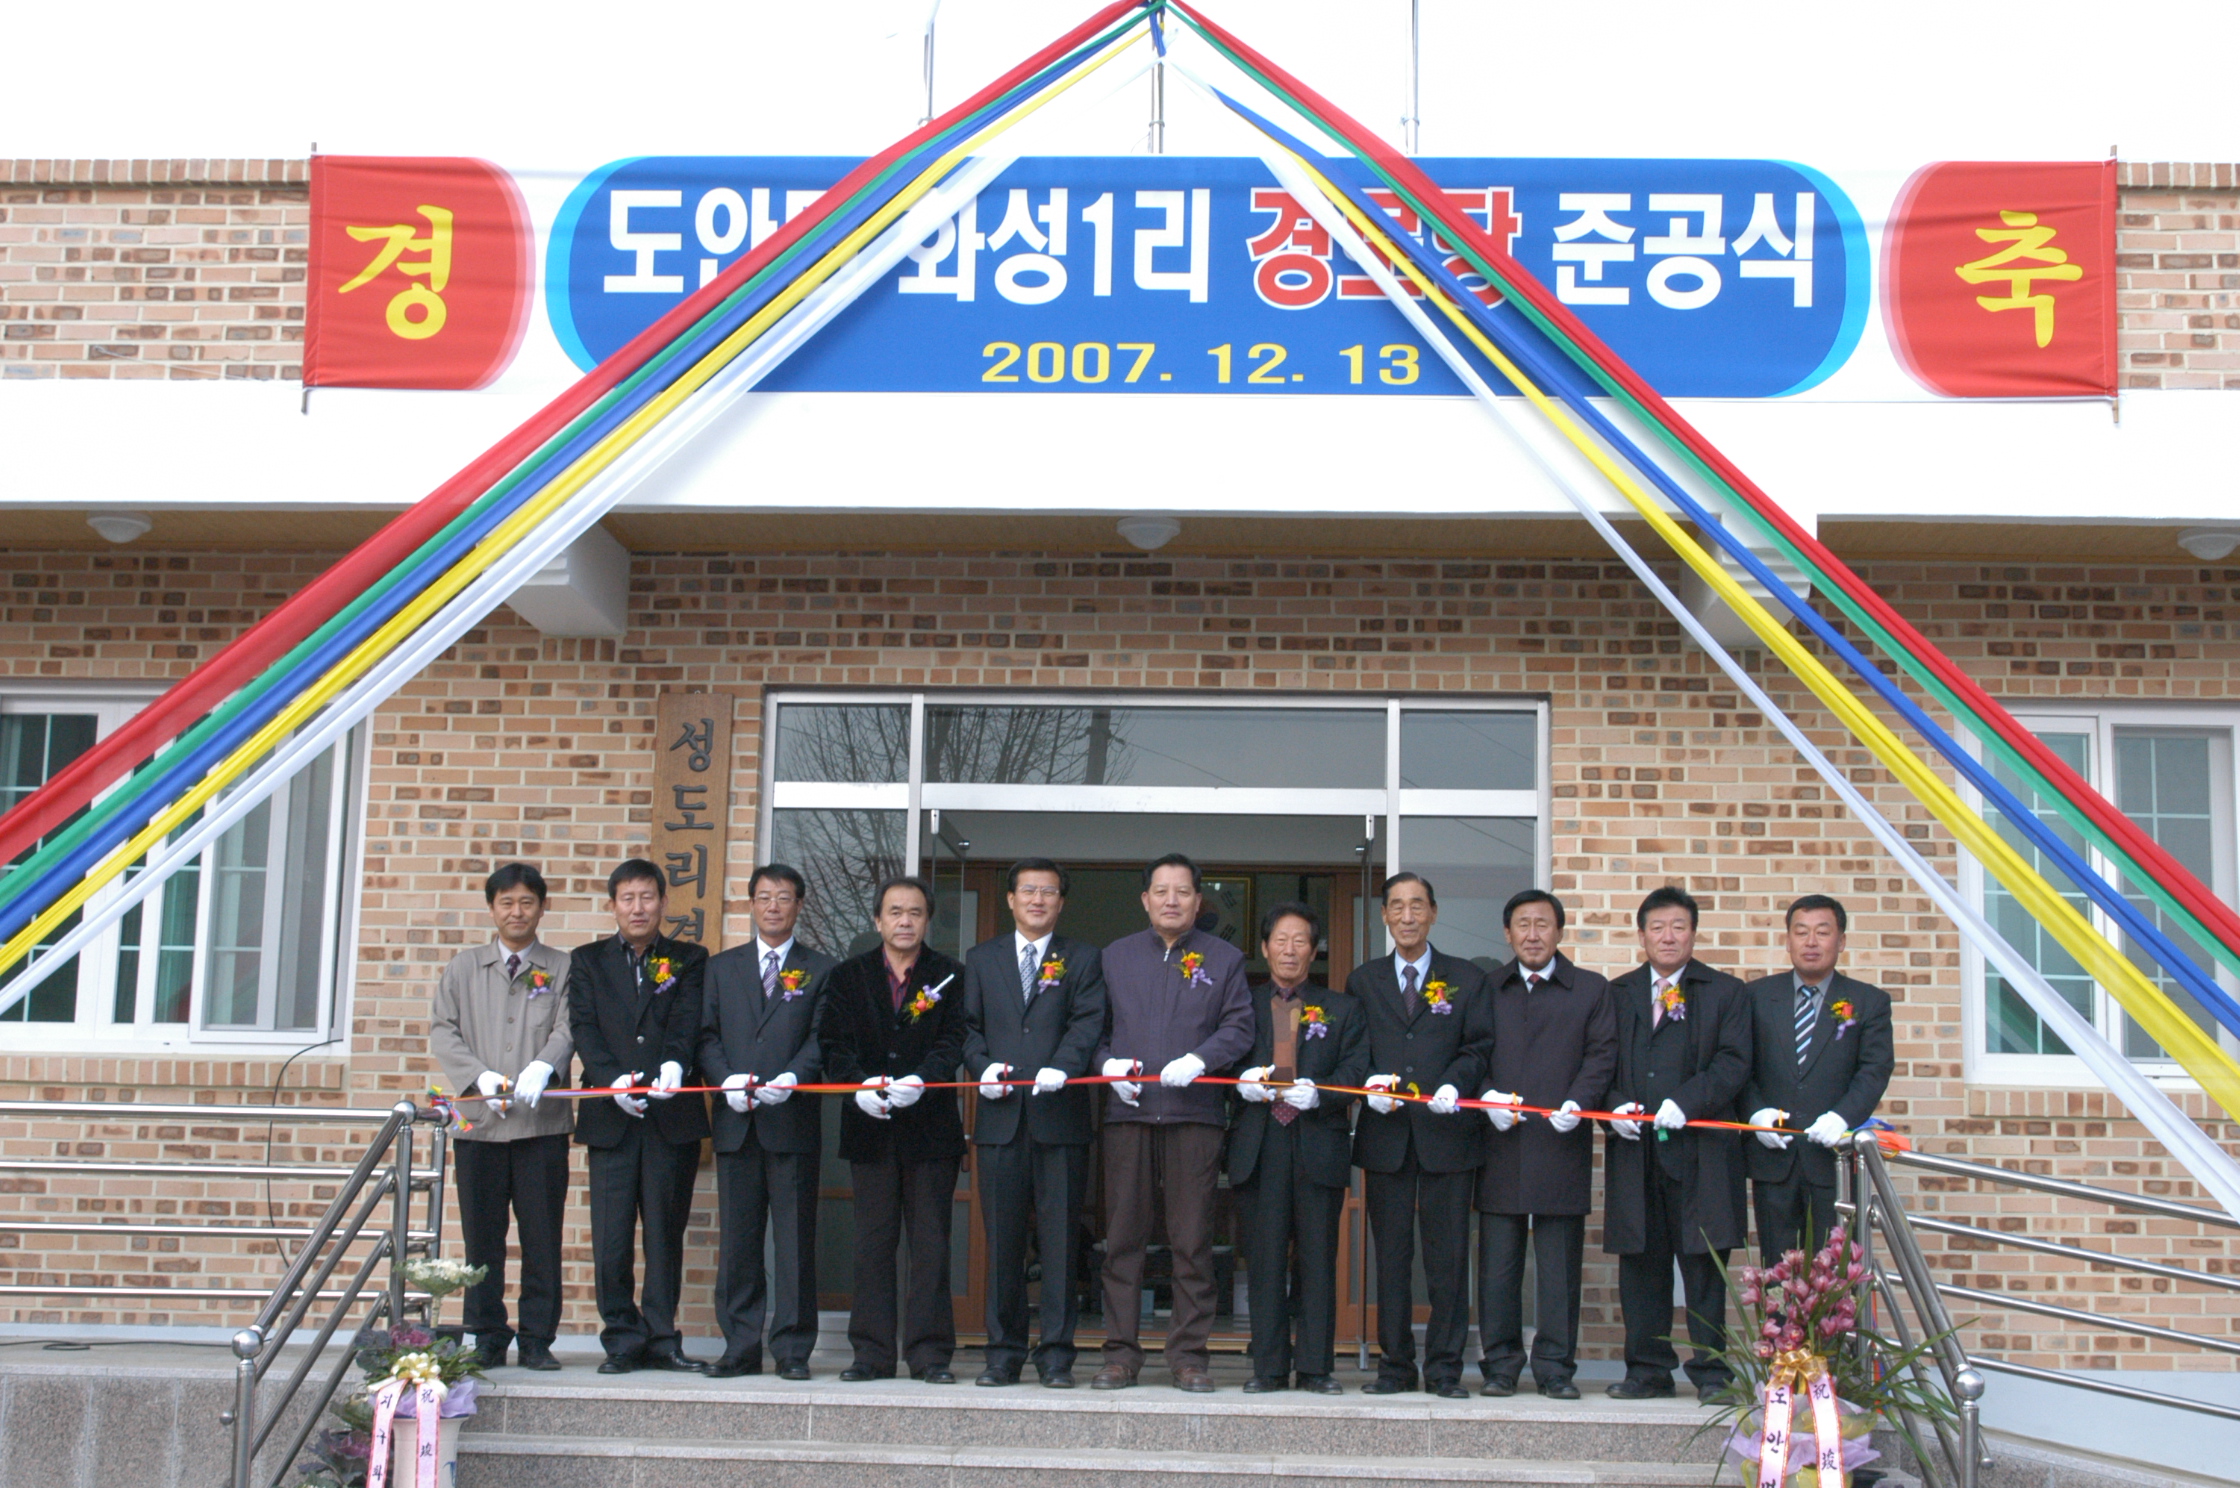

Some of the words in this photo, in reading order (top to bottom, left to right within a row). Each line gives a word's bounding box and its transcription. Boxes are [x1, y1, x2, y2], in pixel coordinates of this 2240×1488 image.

[338, 204, 453, 340] 경
[898, 187, 1211, 305] 화성1리
[1552, 192, 1816, 310] 준공식
[1955, 210, 2083, 348] 축
[982, 342, 1172, 384] 2007.
[1207, 343, 1304, 385] 12.
[1339, 344, 1421, 386] 13
